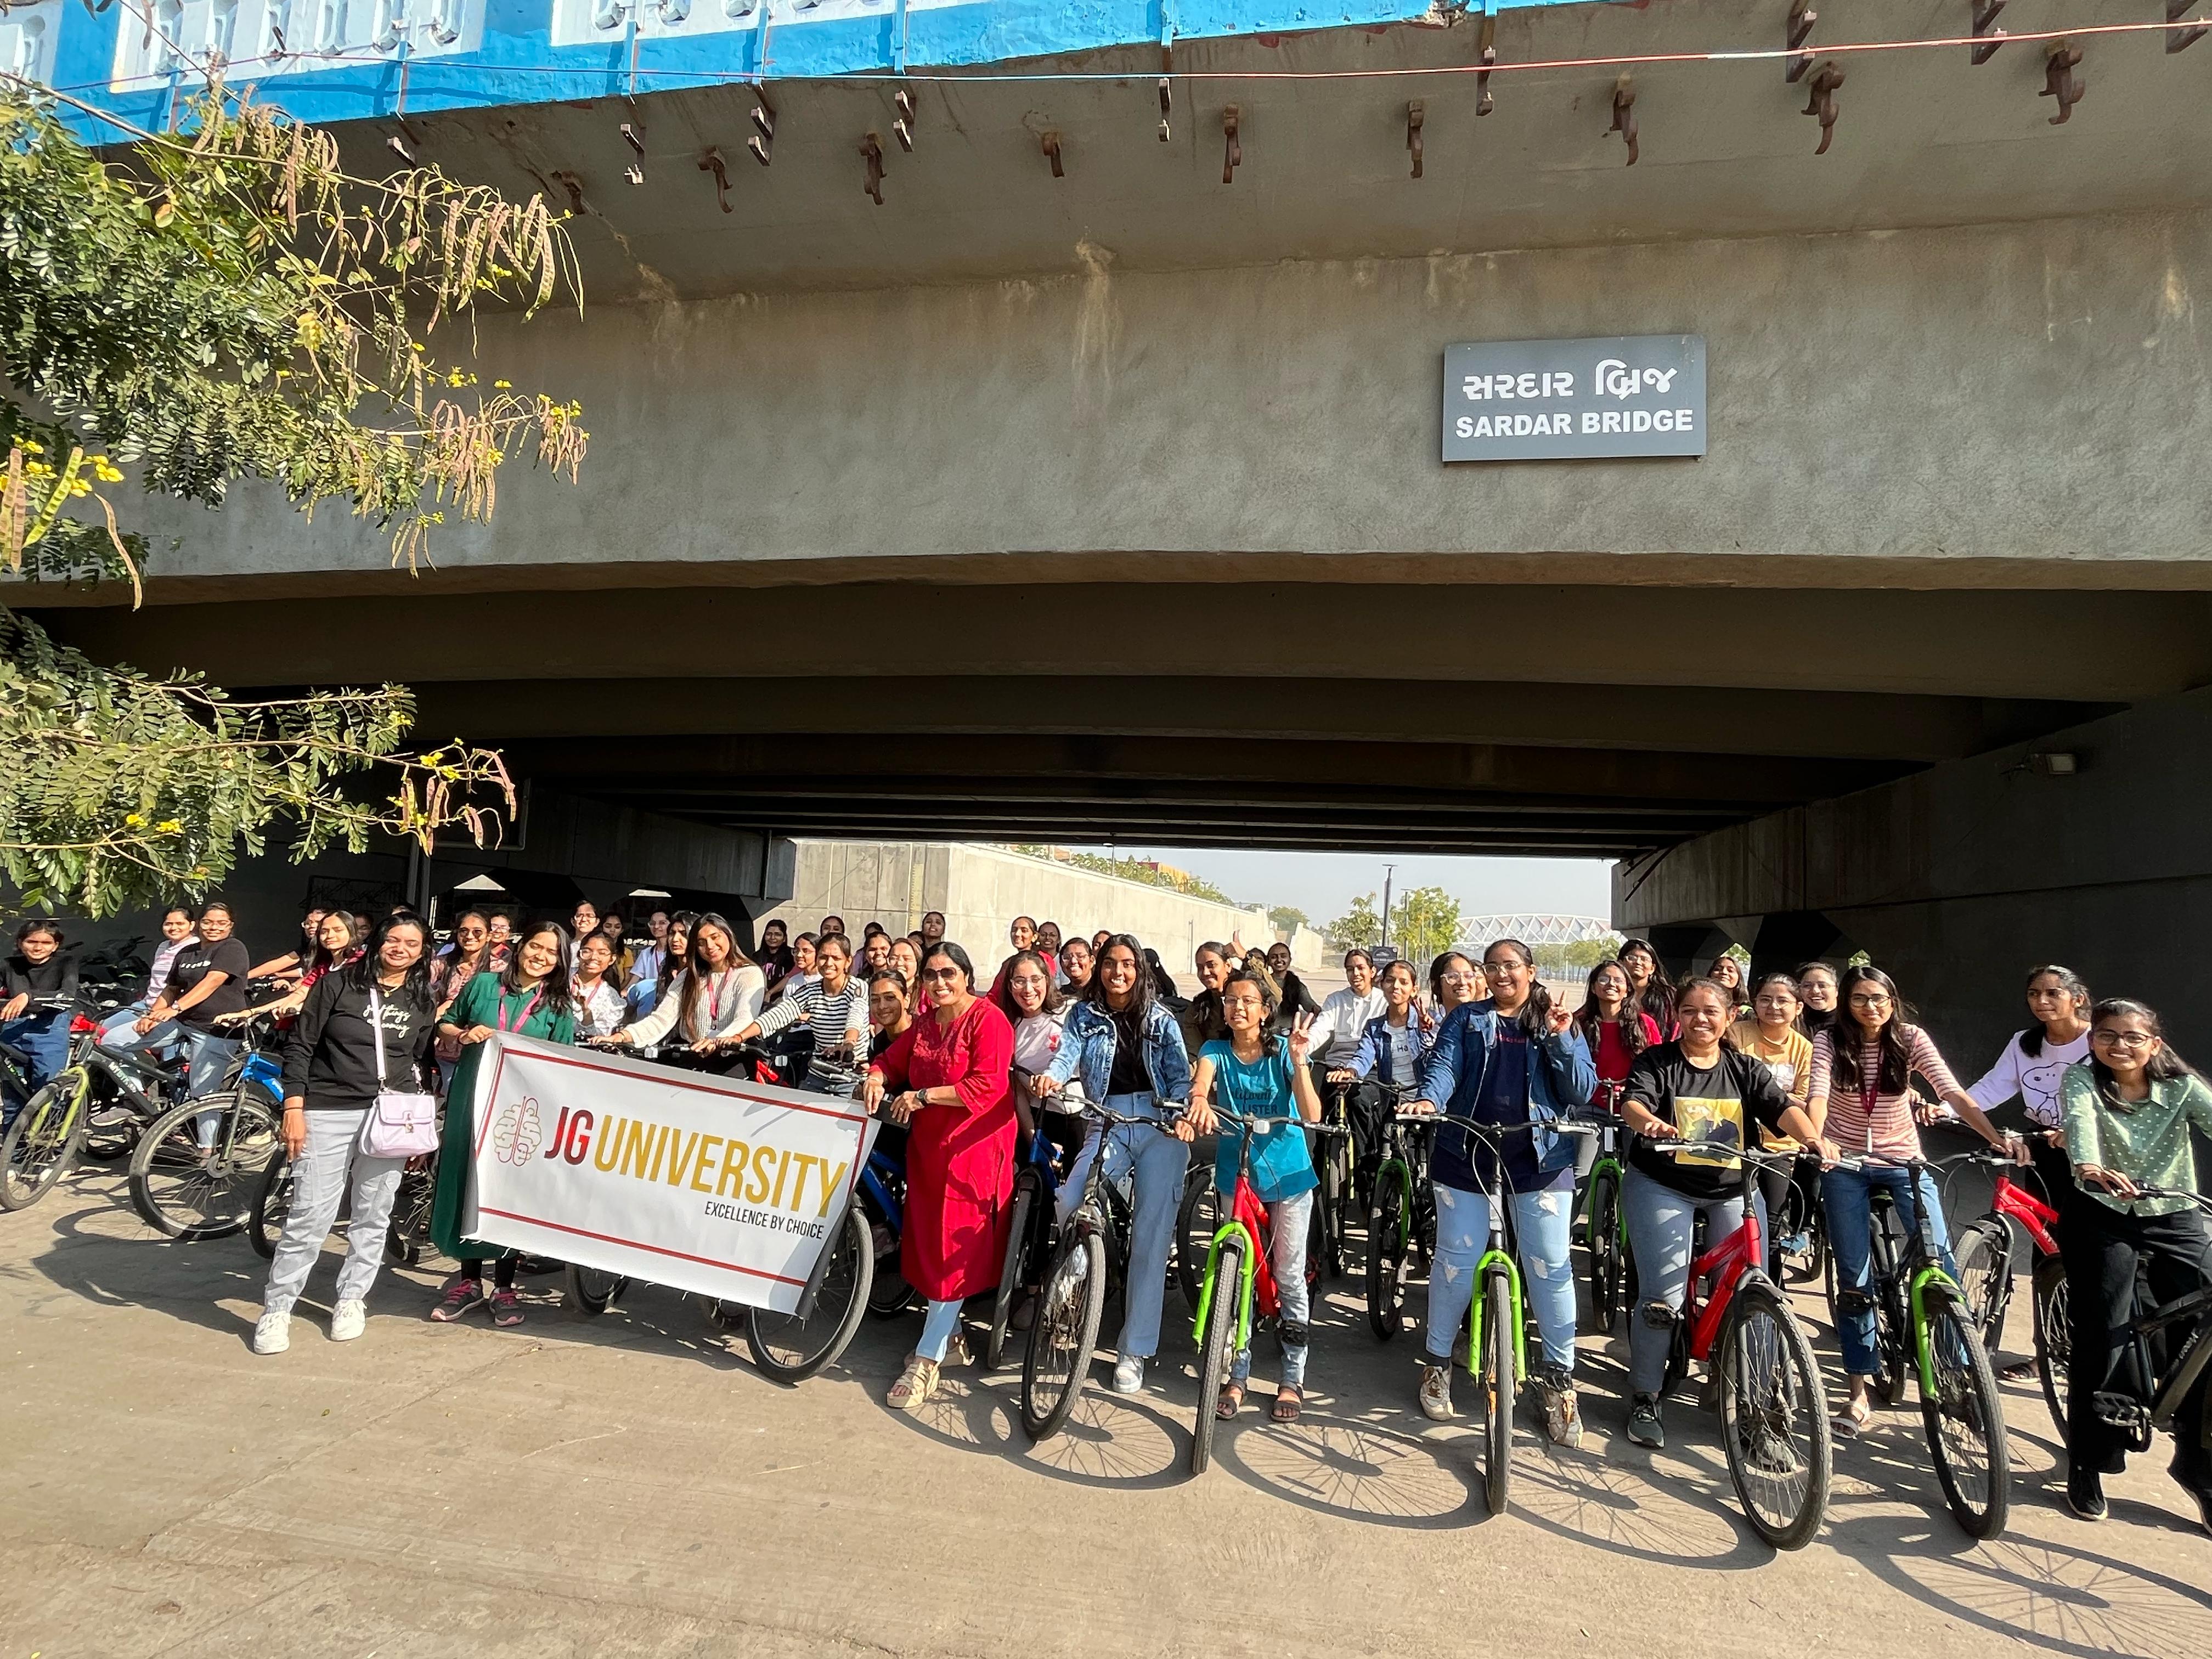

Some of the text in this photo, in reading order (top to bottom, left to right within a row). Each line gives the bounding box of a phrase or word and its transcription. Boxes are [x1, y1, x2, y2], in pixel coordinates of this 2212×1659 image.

[1462, 358, 1678, 400] સરદાર બ્રિજ
[1455, 409, 1694, 438] SARDAR BRIDGE
[544, 1106, 848, 1217] JG UNIVERSITY
[704, 1201, 824, 1239] EXCELLENCE BY CHOICE
